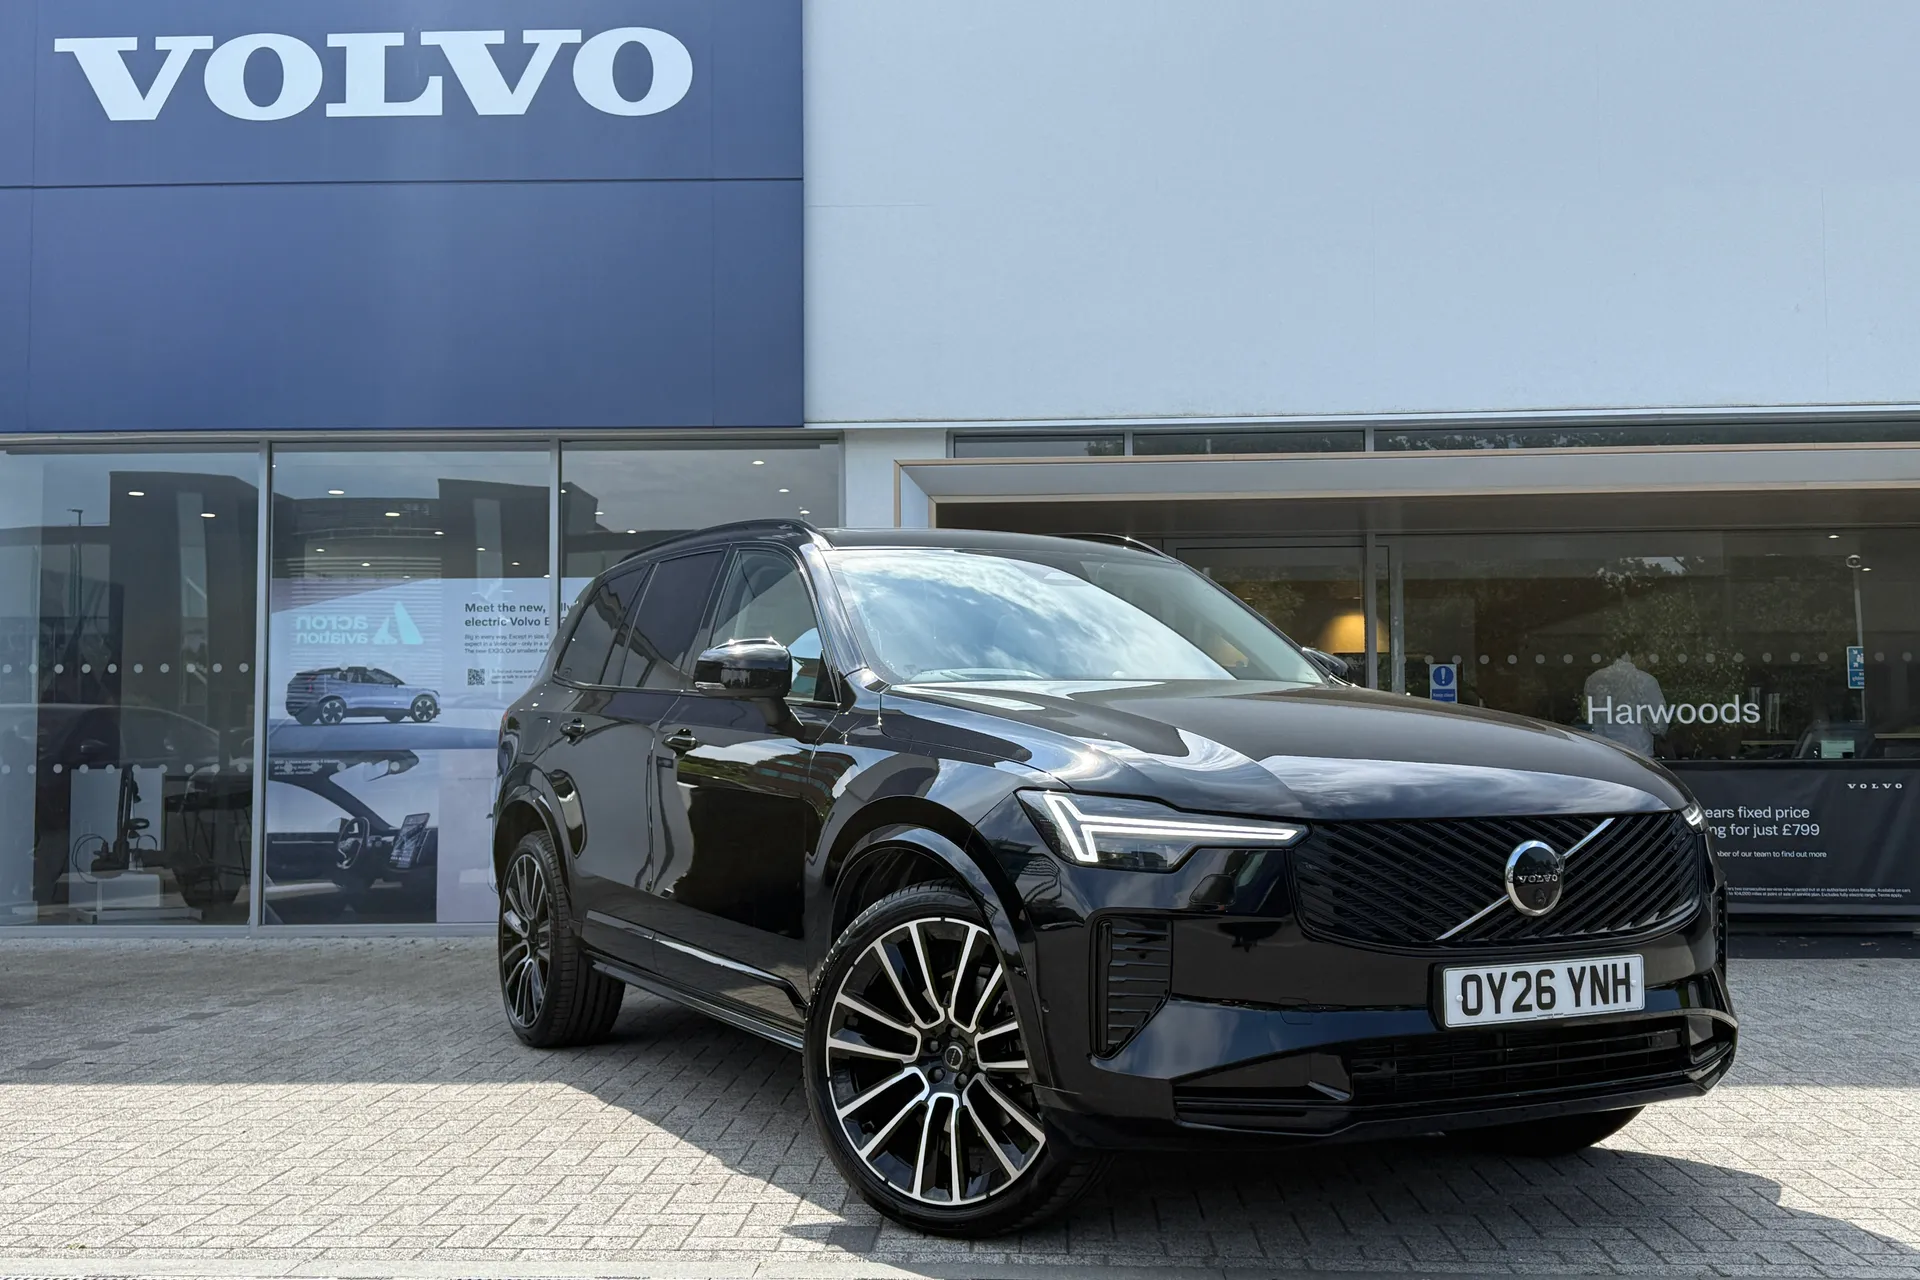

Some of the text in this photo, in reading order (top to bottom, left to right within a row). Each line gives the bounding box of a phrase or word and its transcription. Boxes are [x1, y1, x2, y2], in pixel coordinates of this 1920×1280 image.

[54, 27, 693, 121] VOLVO
[465, 603, 495, 613] Meet
[497, 603, 516, 613] the
[519, 604, 546, 614] new,
[464, 617, 507, 627] electric
[510, 617, 541, 627] Volvo
[1587, 694, 1761, 724] Harwoods
[1703, 806, 1810, 821] ears fixed price
[1730, 823, 1750, 836] for
[1753, 823, 1778, 839] just
[1782, 823, 1820, 836] £799
[1517, 874, 1558, 883] VOLVO
[1461, 962, 1632, 1016] OY26 YNH
